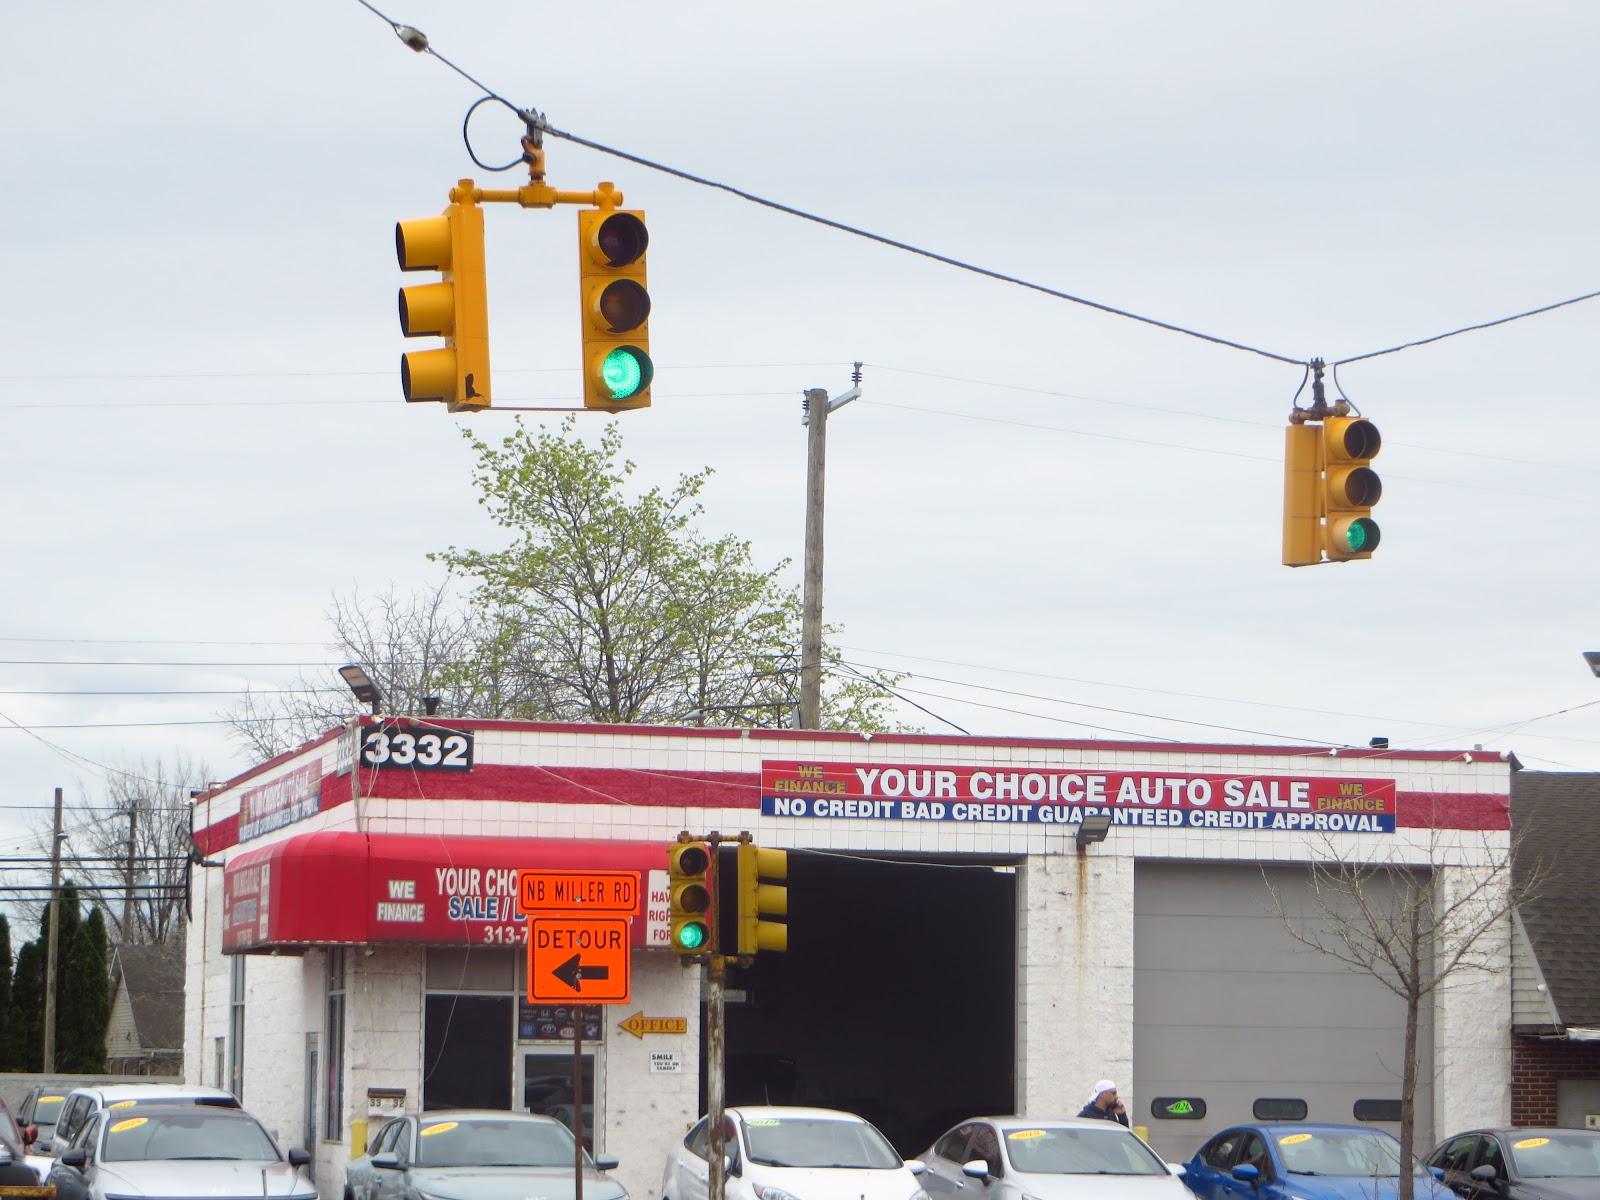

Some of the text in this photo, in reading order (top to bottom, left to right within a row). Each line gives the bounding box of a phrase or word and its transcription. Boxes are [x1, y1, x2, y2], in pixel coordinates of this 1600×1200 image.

[365, 732, 467, 765] 3332
[797, 765, 823, 779] WE
[774, 779, 846, 795] FINANCE
[855, 767, 1310, 808] YOUR CHOICE AUTO SALE
[1340, 783, 1363, 796] WE
[1317, 797, 1385, 811] FINANCE
[774, 798, 808, 816] NO
[813, 799, 895, 818] CREDIT
[902, 802, 946, 820] BAD
[952, 804, 1032, 822] CREDIT
[1189, 810, 1267, 829] CREDIT
[1272, 812, 1383, 832] APPROVAL
[388, 880, 416, 899] WE
[436, 868, 518, 897] YOUR CHO
[527, 880, 631, 902] NB MILLER RD
[651, 891, 671, 903] HAV
[376, 903, 425, 922] FINANCE
[448, 896, 499, 921] SALE
[649, 910, 671, 922] RIG
[538, 930, 622, 949] DETOUR
[628, 1019, 685, 1031] OFFICE
[370, 1098, 405, 1108] 33 32
